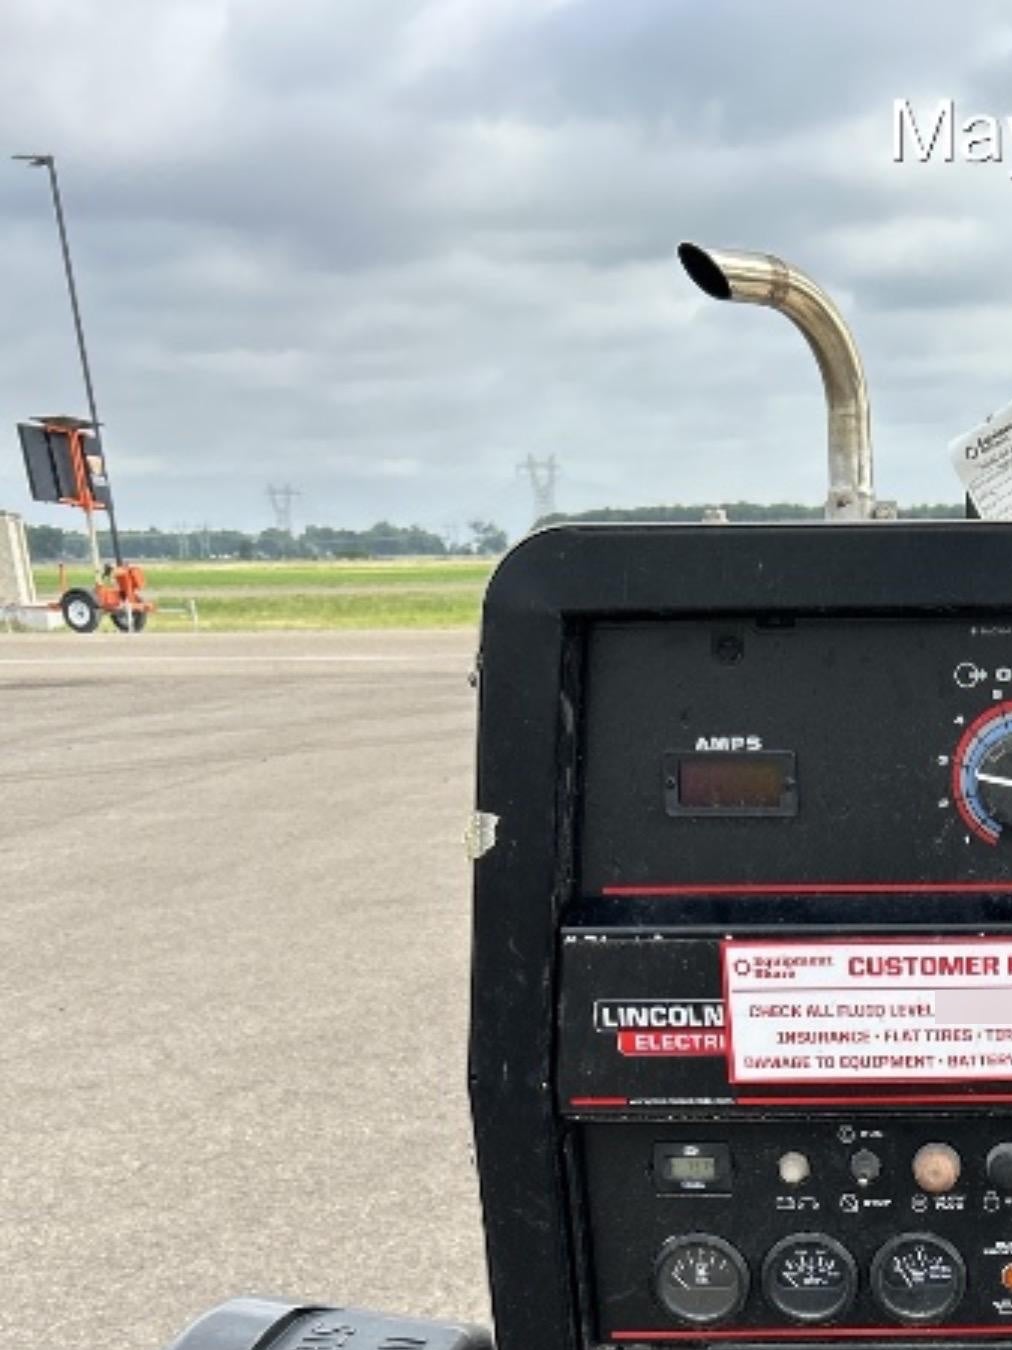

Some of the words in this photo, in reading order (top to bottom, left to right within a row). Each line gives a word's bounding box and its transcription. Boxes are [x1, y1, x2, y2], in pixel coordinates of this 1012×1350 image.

[695, 736, 763, 752] AMPS
[848, 955, 999, 977] CUSTOMER
[602, 1004, 724, 1028] LINCOLN
[749, 1004, 802, 1018] CHECK
[806, 1003, 835, 1018] ALL
[837, 1003, 886, 1018] FLUID
[635, 1033, 725, 1051] ELECTRI
[776, 1030, 871, 1045] INSURANCE
[884, 1028, 920, 1043] FLAT
[921, 1028, 974, 1042] TIRES
[744, 1054, 812, 1070] DAMAGE
[815, 1054, 836, 1069] TO
[839, 1053, 934, 1071] EQUIPMENT
